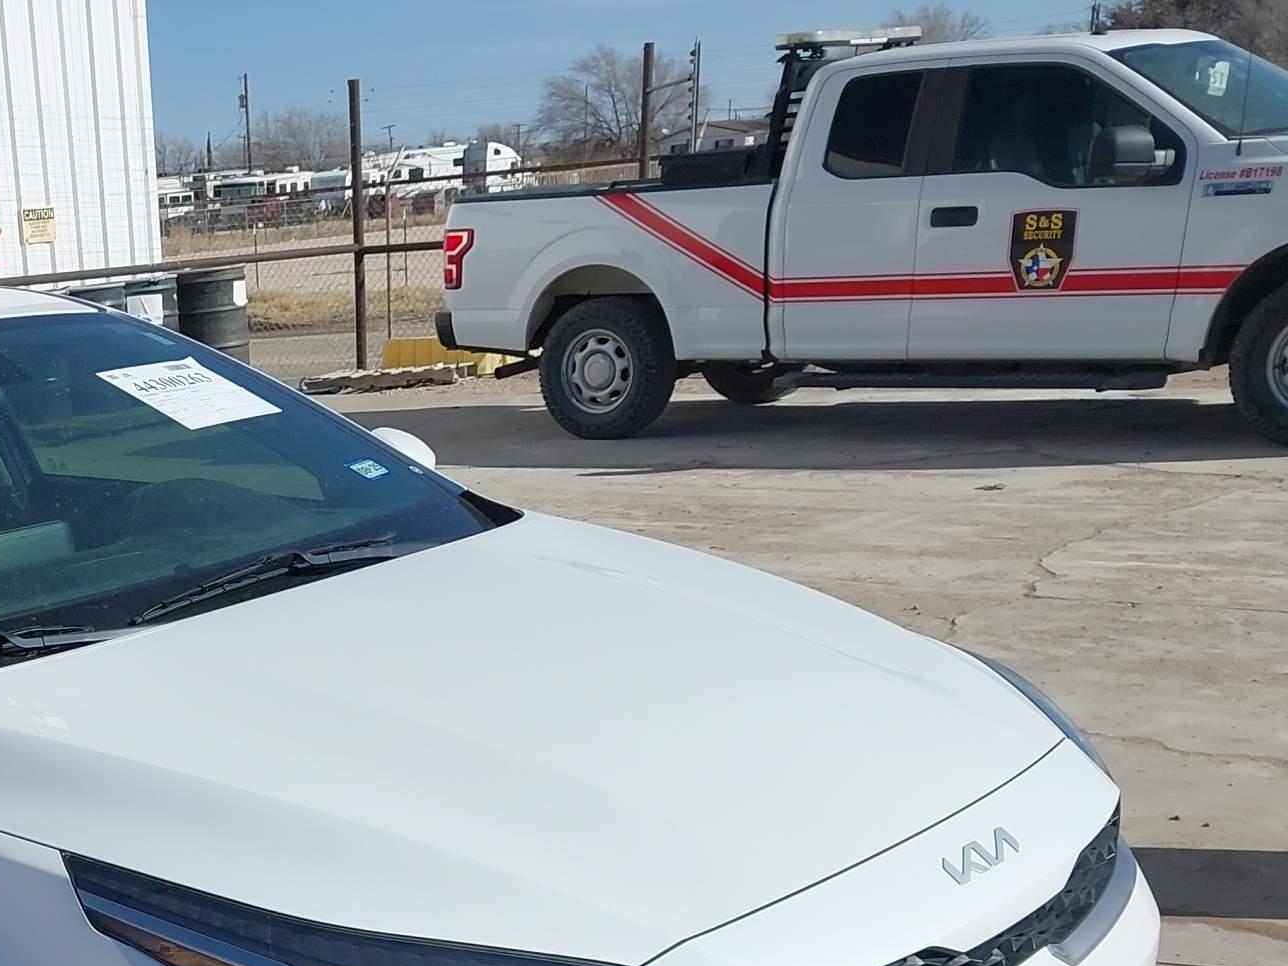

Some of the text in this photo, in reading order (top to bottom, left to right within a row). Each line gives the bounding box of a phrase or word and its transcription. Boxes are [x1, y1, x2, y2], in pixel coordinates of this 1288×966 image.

[1200, 171, 1237, 181] License
[23, 209, 54, 221] CAUTION
[1026, 213, 1062, 230] S&S
[1024, 231, 1062, 240] SECURITY
[132, 371, 214, 393] 44300263
[941, 826, 1020, 886] KIA
